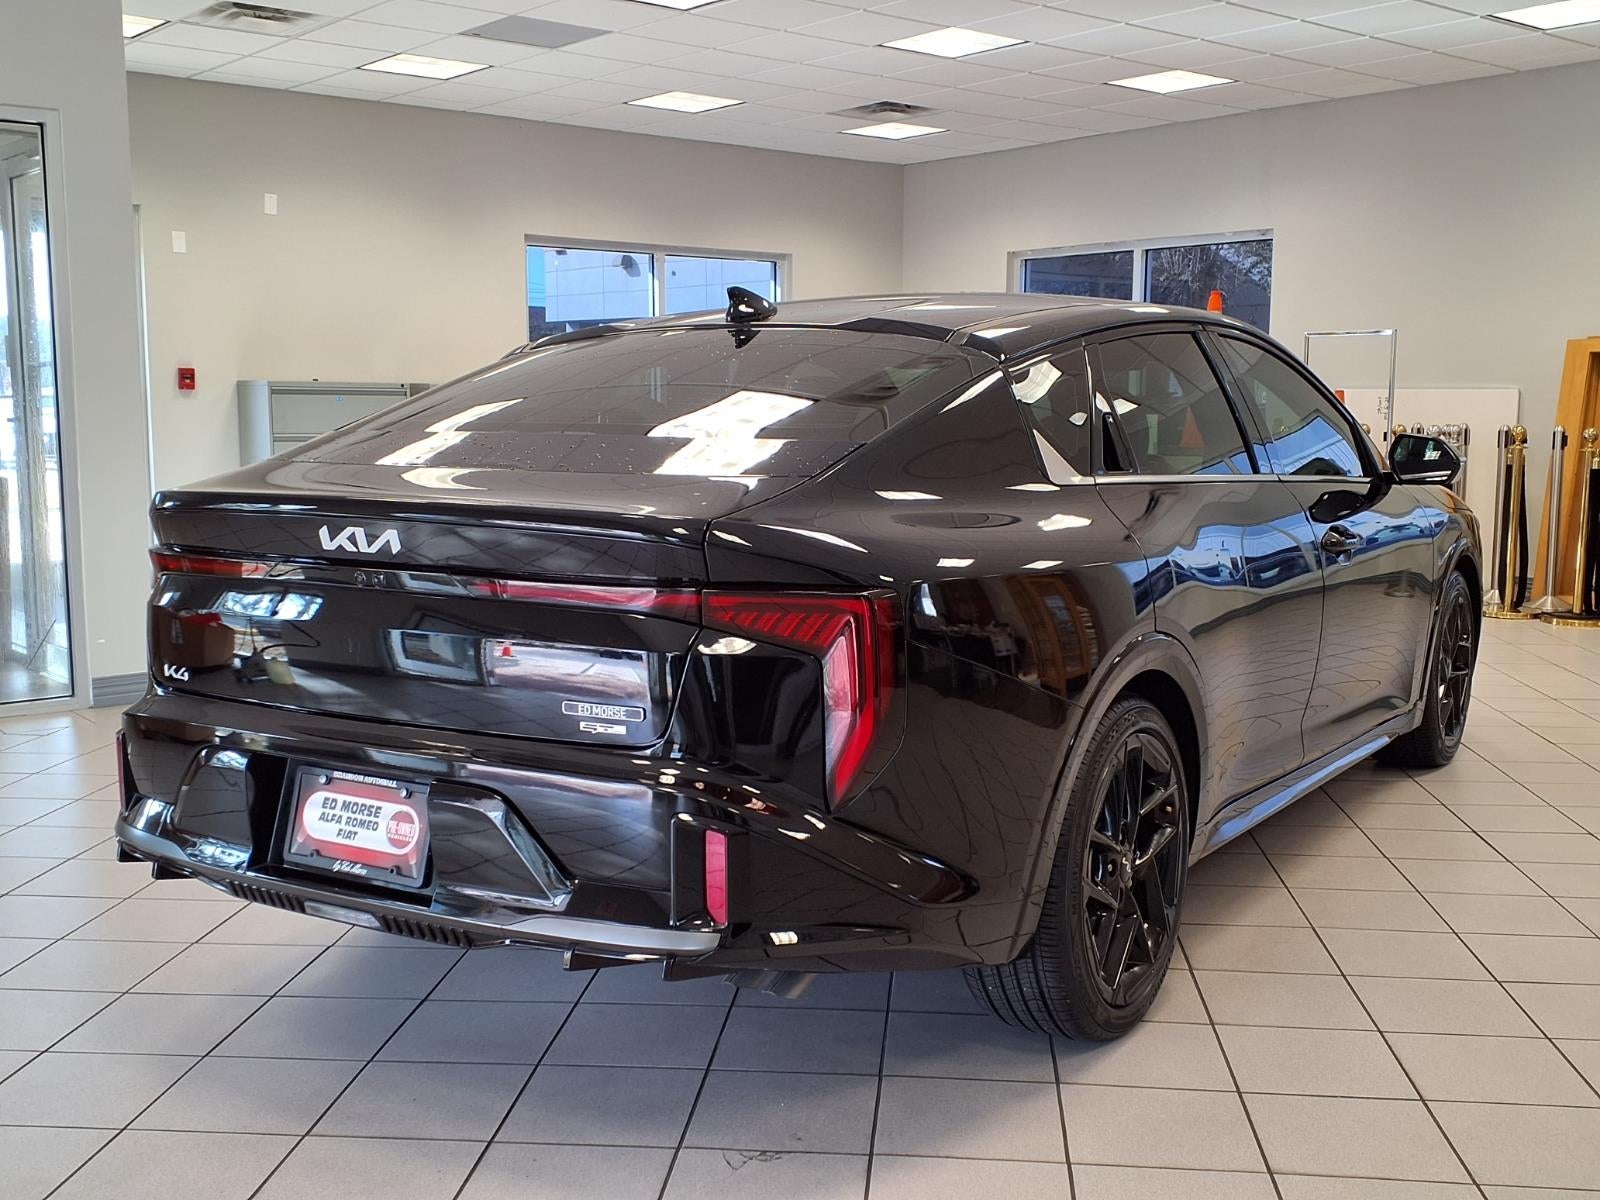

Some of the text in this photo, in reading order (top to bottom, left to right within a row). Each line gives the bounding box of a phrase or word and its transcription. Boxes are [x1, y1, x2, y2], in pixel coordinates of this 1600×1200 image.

[318, 525, 402, 555] KIA
[163, 663, 189, 682] K4
[578, 704, 626, 719] ED MORSE
[321, 797, 383, 818] ED MORSE
[318, 812, 379, 831] ALFA ROMEO
[336, 828, 358, 841] FIAT
